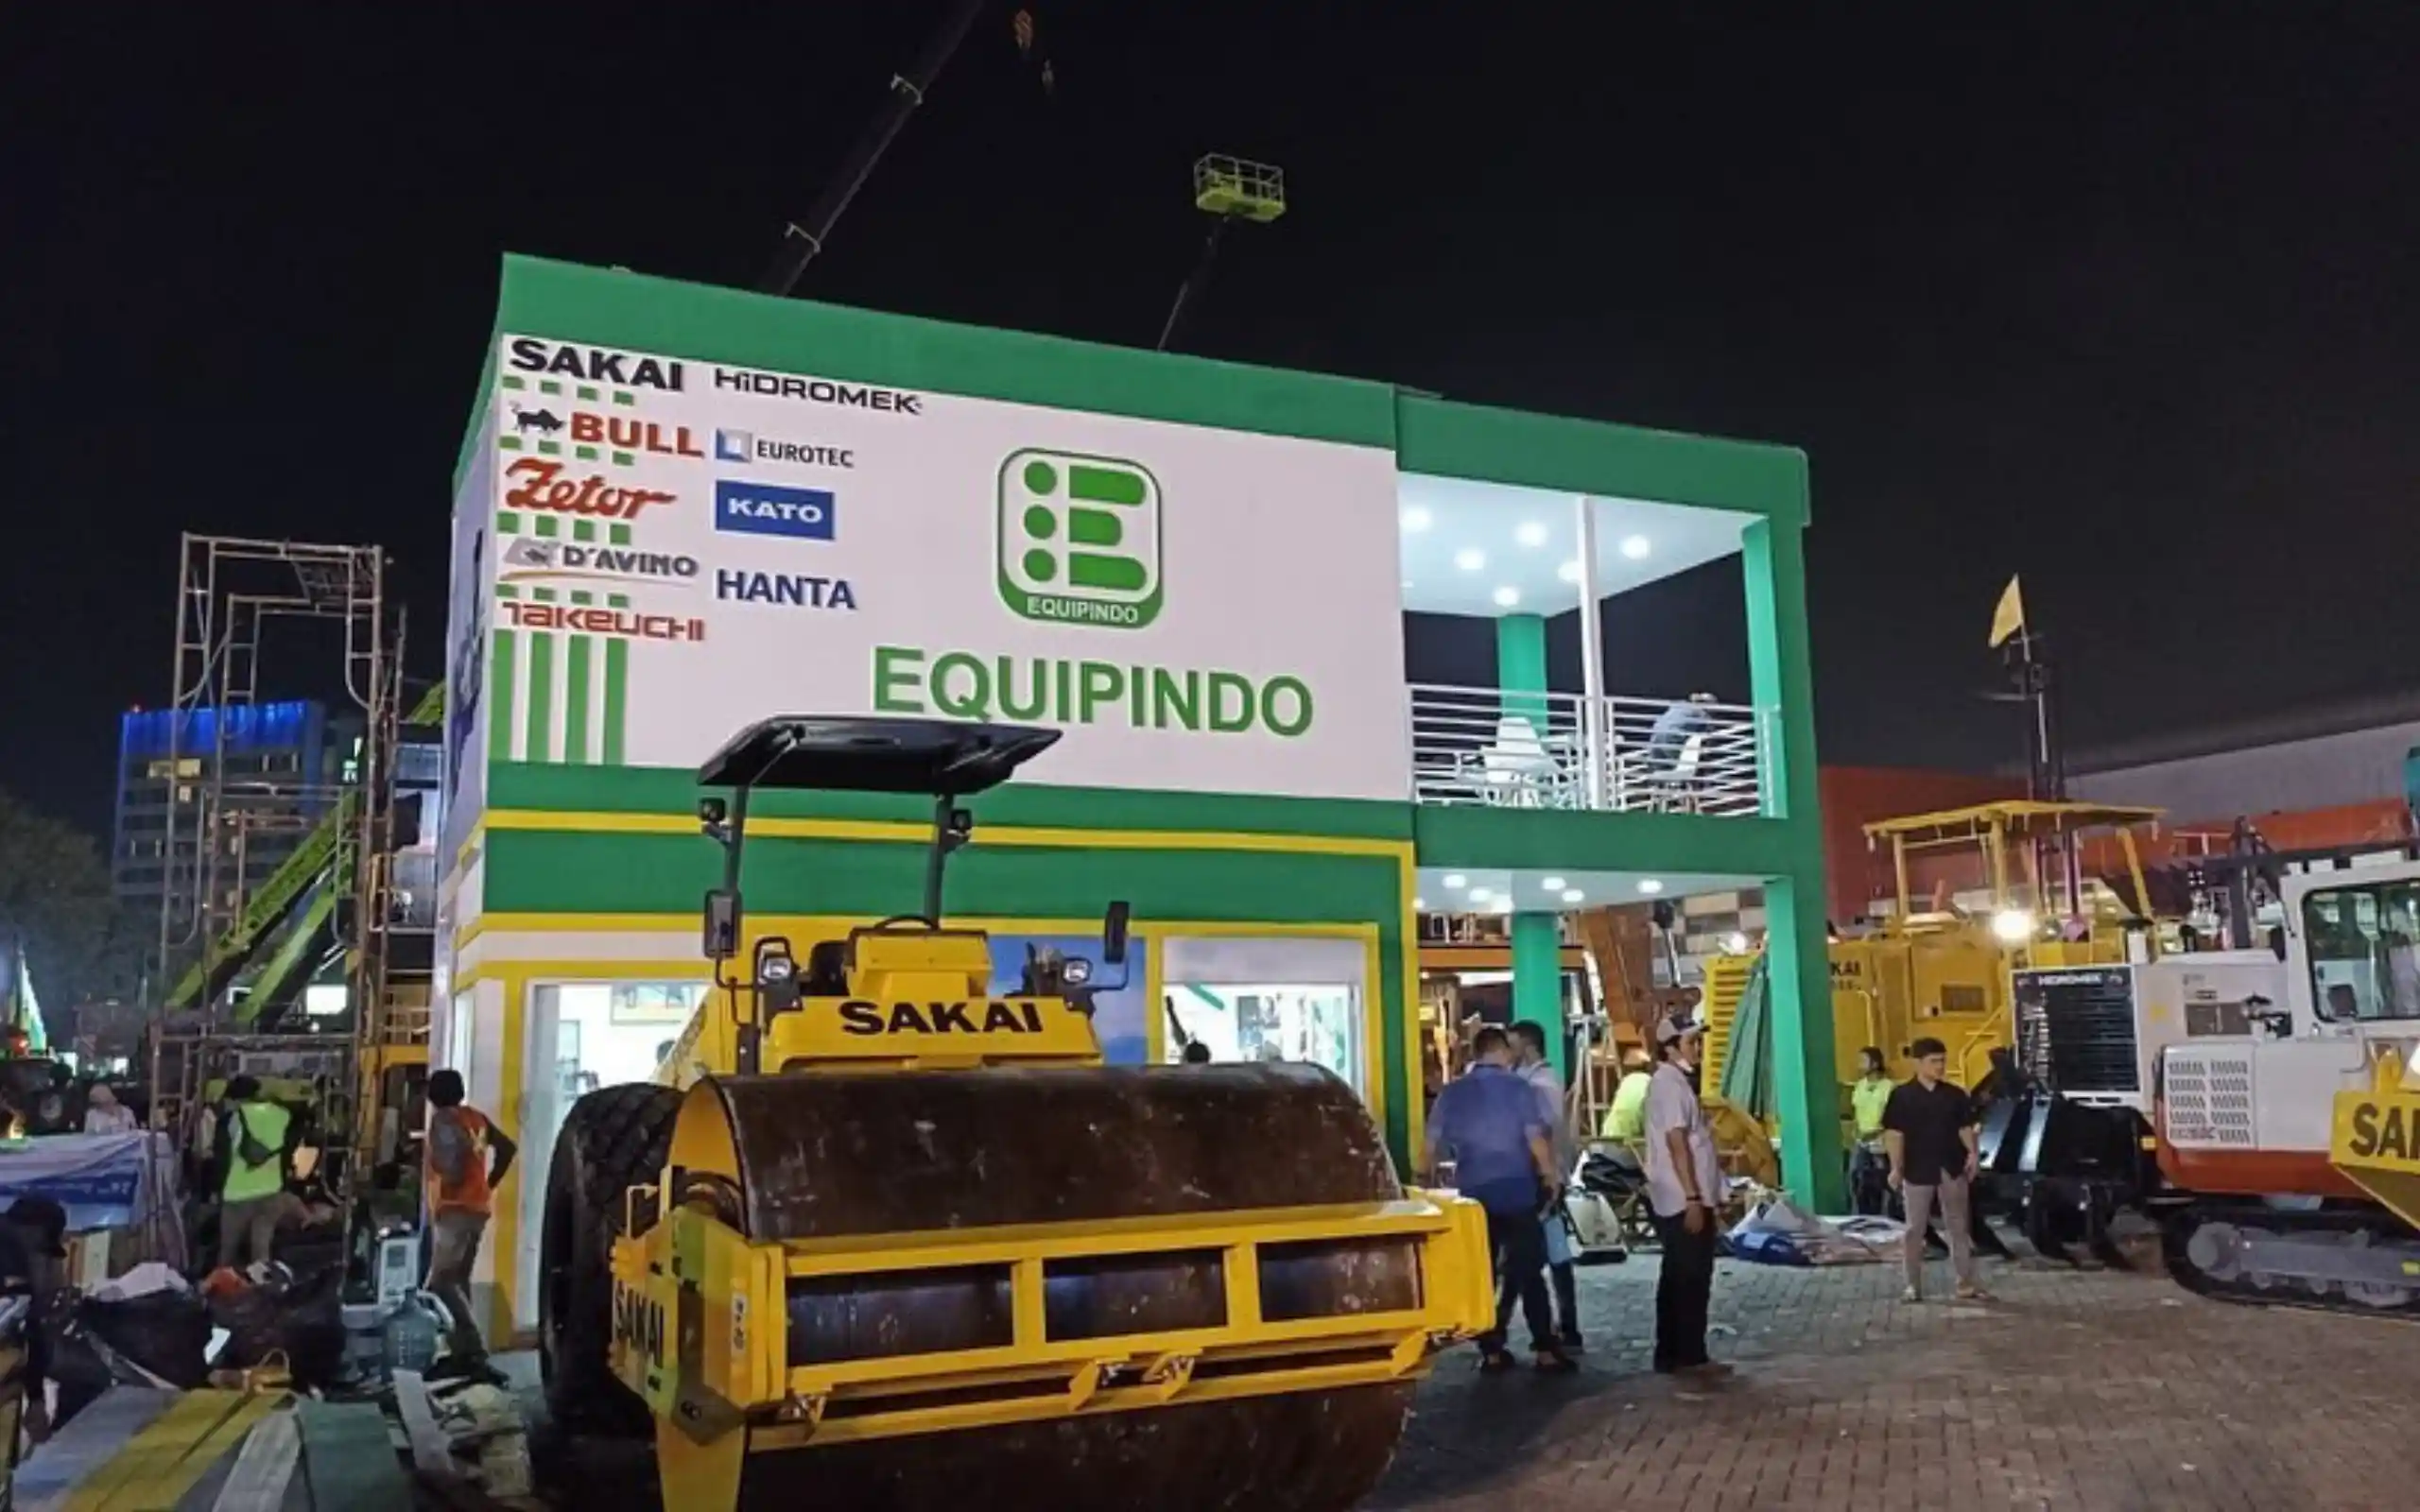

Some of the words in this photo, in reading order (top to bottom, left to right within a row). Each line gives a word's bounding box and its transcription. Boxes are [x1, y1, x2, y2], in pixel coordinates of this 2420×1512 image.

[510, 340, 684, 392] SAKAI
[571, 412, 704, 458] BULL
[757, 440, 854, 468] EUROTEC
[505, 458, 677, 520] Zetor
[727, 497, 822, 524] KATO
[716, 570, 856, 610] HANTA
[1027, 596, 1139, 625] EQUIPINDO
[873, 645, 1315, 738] EQUIPINDO
[838, 1001, 1044, 1036] SAKAI
[2348, 1102, 2420, 1160] SA
[614, 1280, 665, 1370] SAKAI
